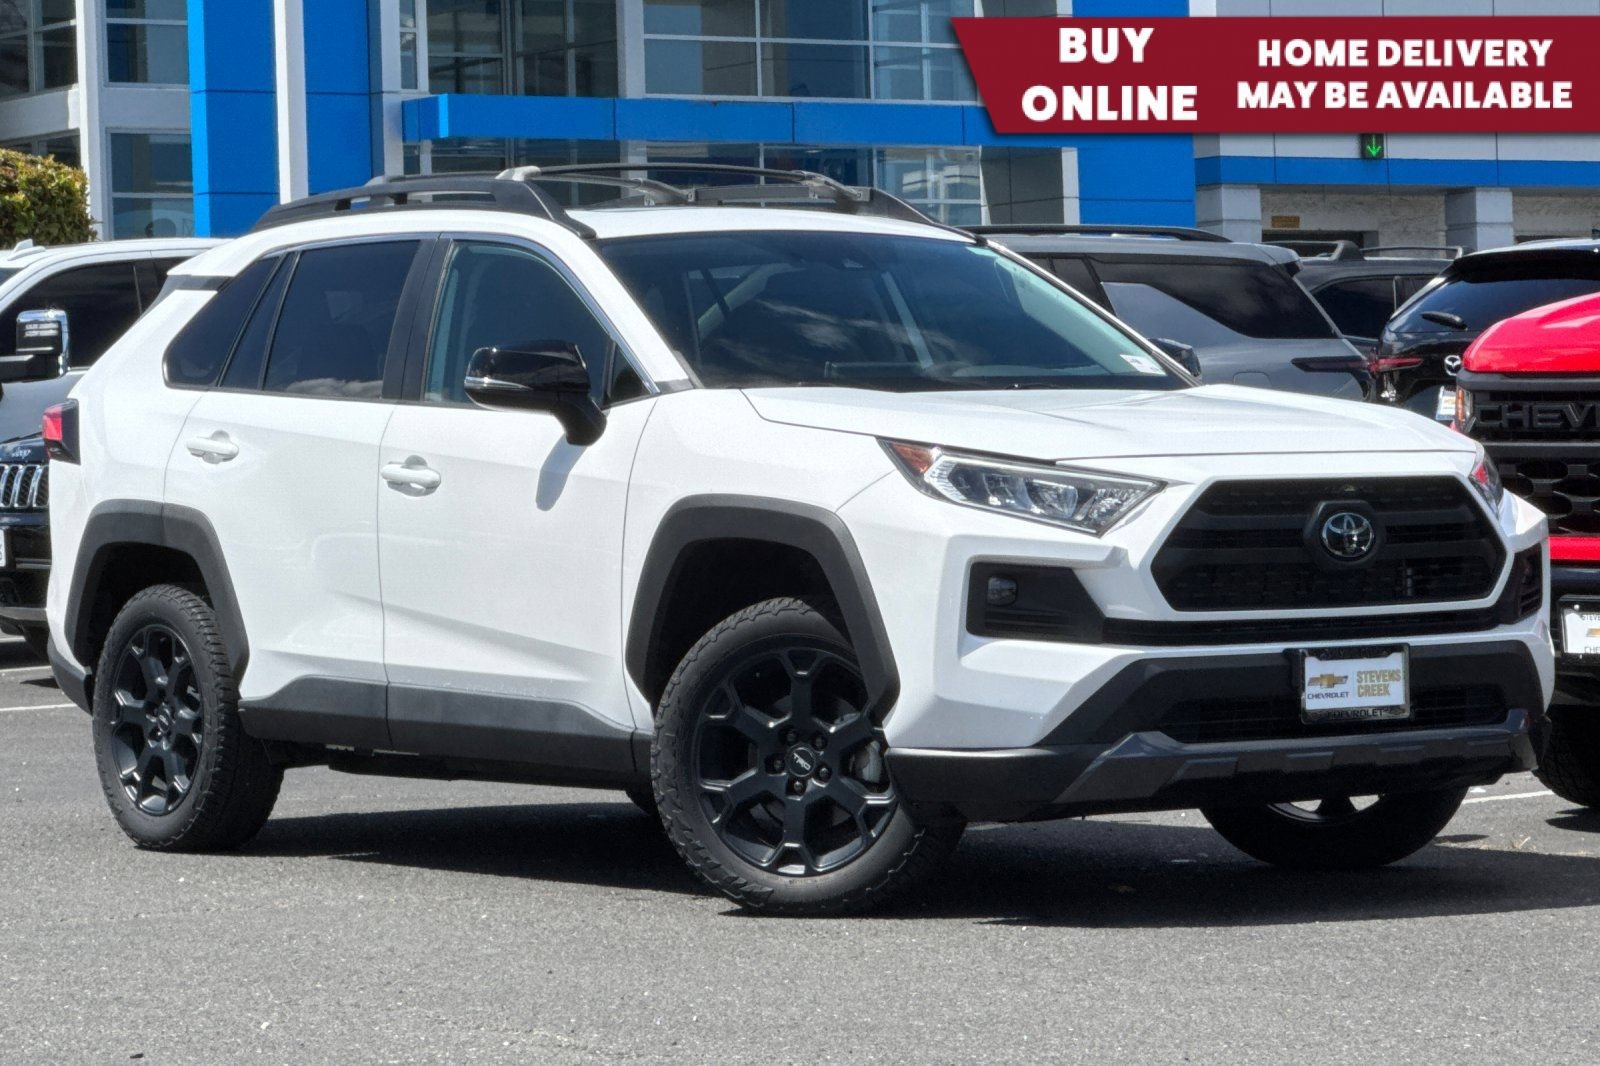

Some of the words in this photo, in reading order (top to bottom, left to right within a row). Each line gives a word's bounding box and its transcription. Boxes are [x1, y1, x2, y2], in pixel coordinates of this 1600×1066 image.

[1474, 402, 1600, 429] CHEV
[1356, 669, 1402, 684] STEVENS
[1306, 691, 1350, 700] CHEVROLET
[1357, 683, 1391, 698] CREEK
